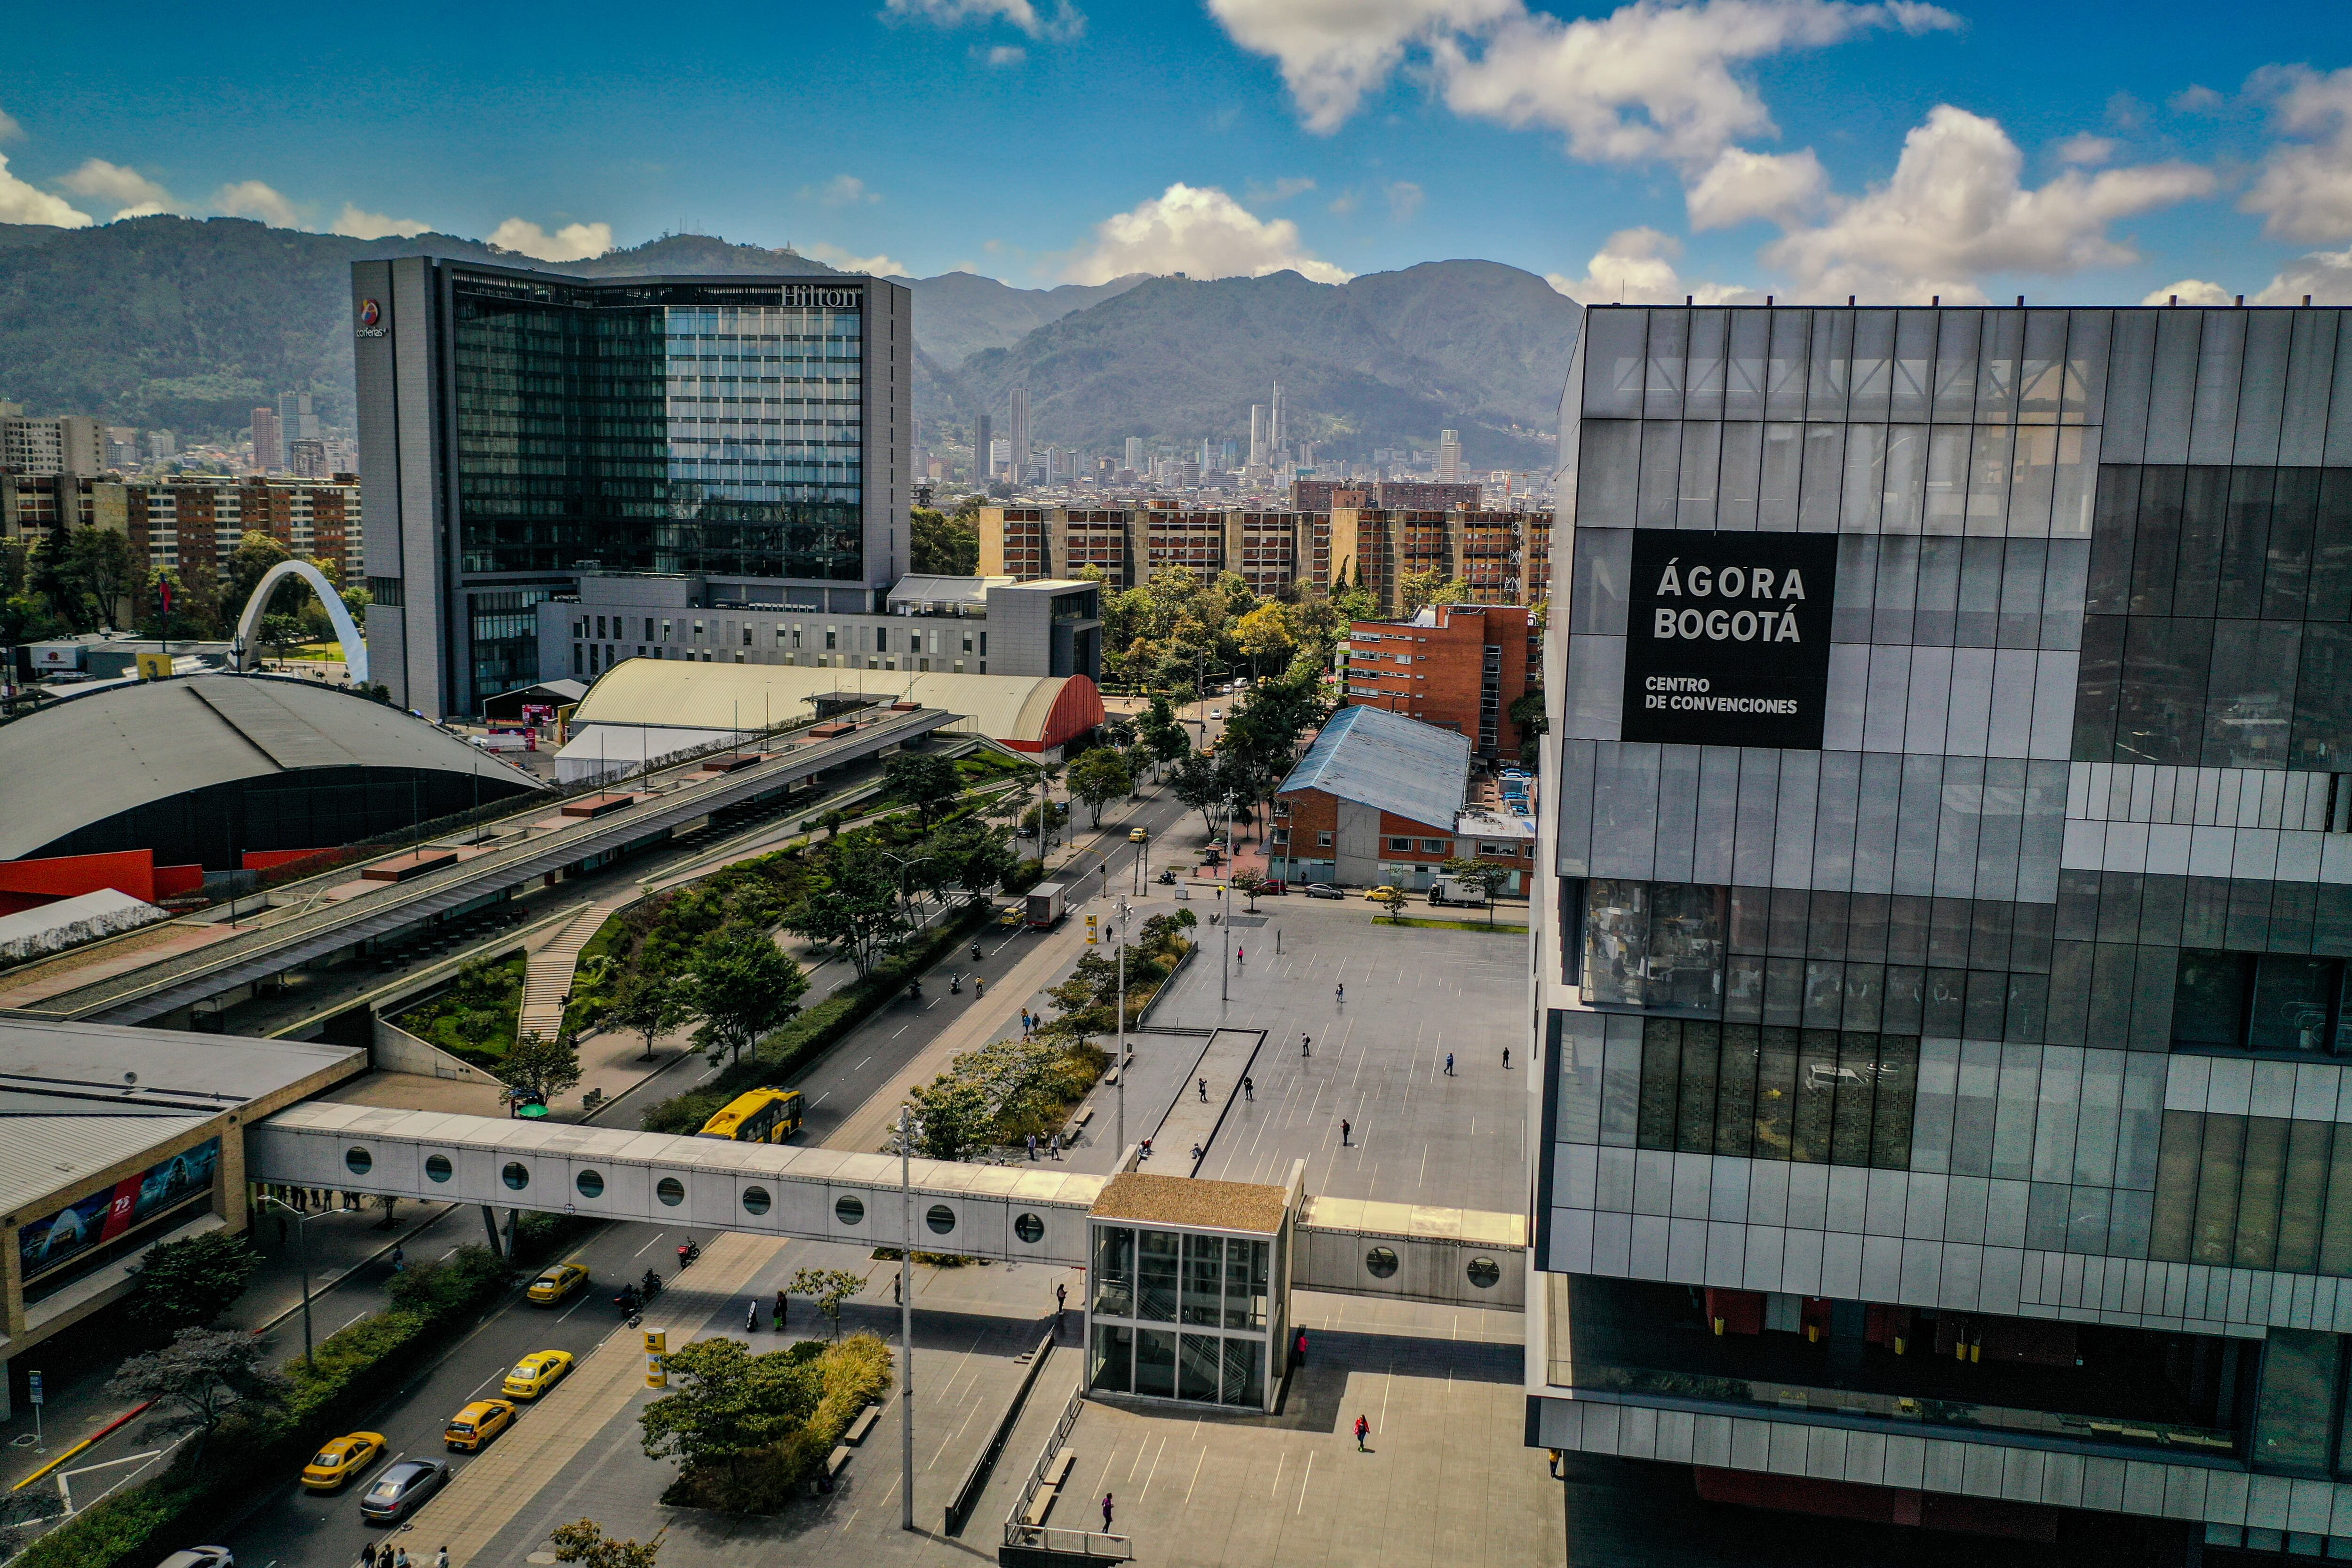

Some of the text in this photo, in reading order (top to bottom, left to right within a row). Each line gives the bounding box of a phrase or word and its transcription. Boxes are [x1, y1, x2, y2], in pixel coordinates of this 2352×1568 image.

[781, 285, 857, 306] Hilton
[356, 327, 383, 337] corferias
[1656, 557, 1805, 600] ÁGORA
[1654, 604, 1801, 642] BOGOTÁ
[146, 660, 158, 679] 3
[1645, 676, 1710, 692] CENTRO
[1645, 695, 1797, 714] DE CONVENCIONES
